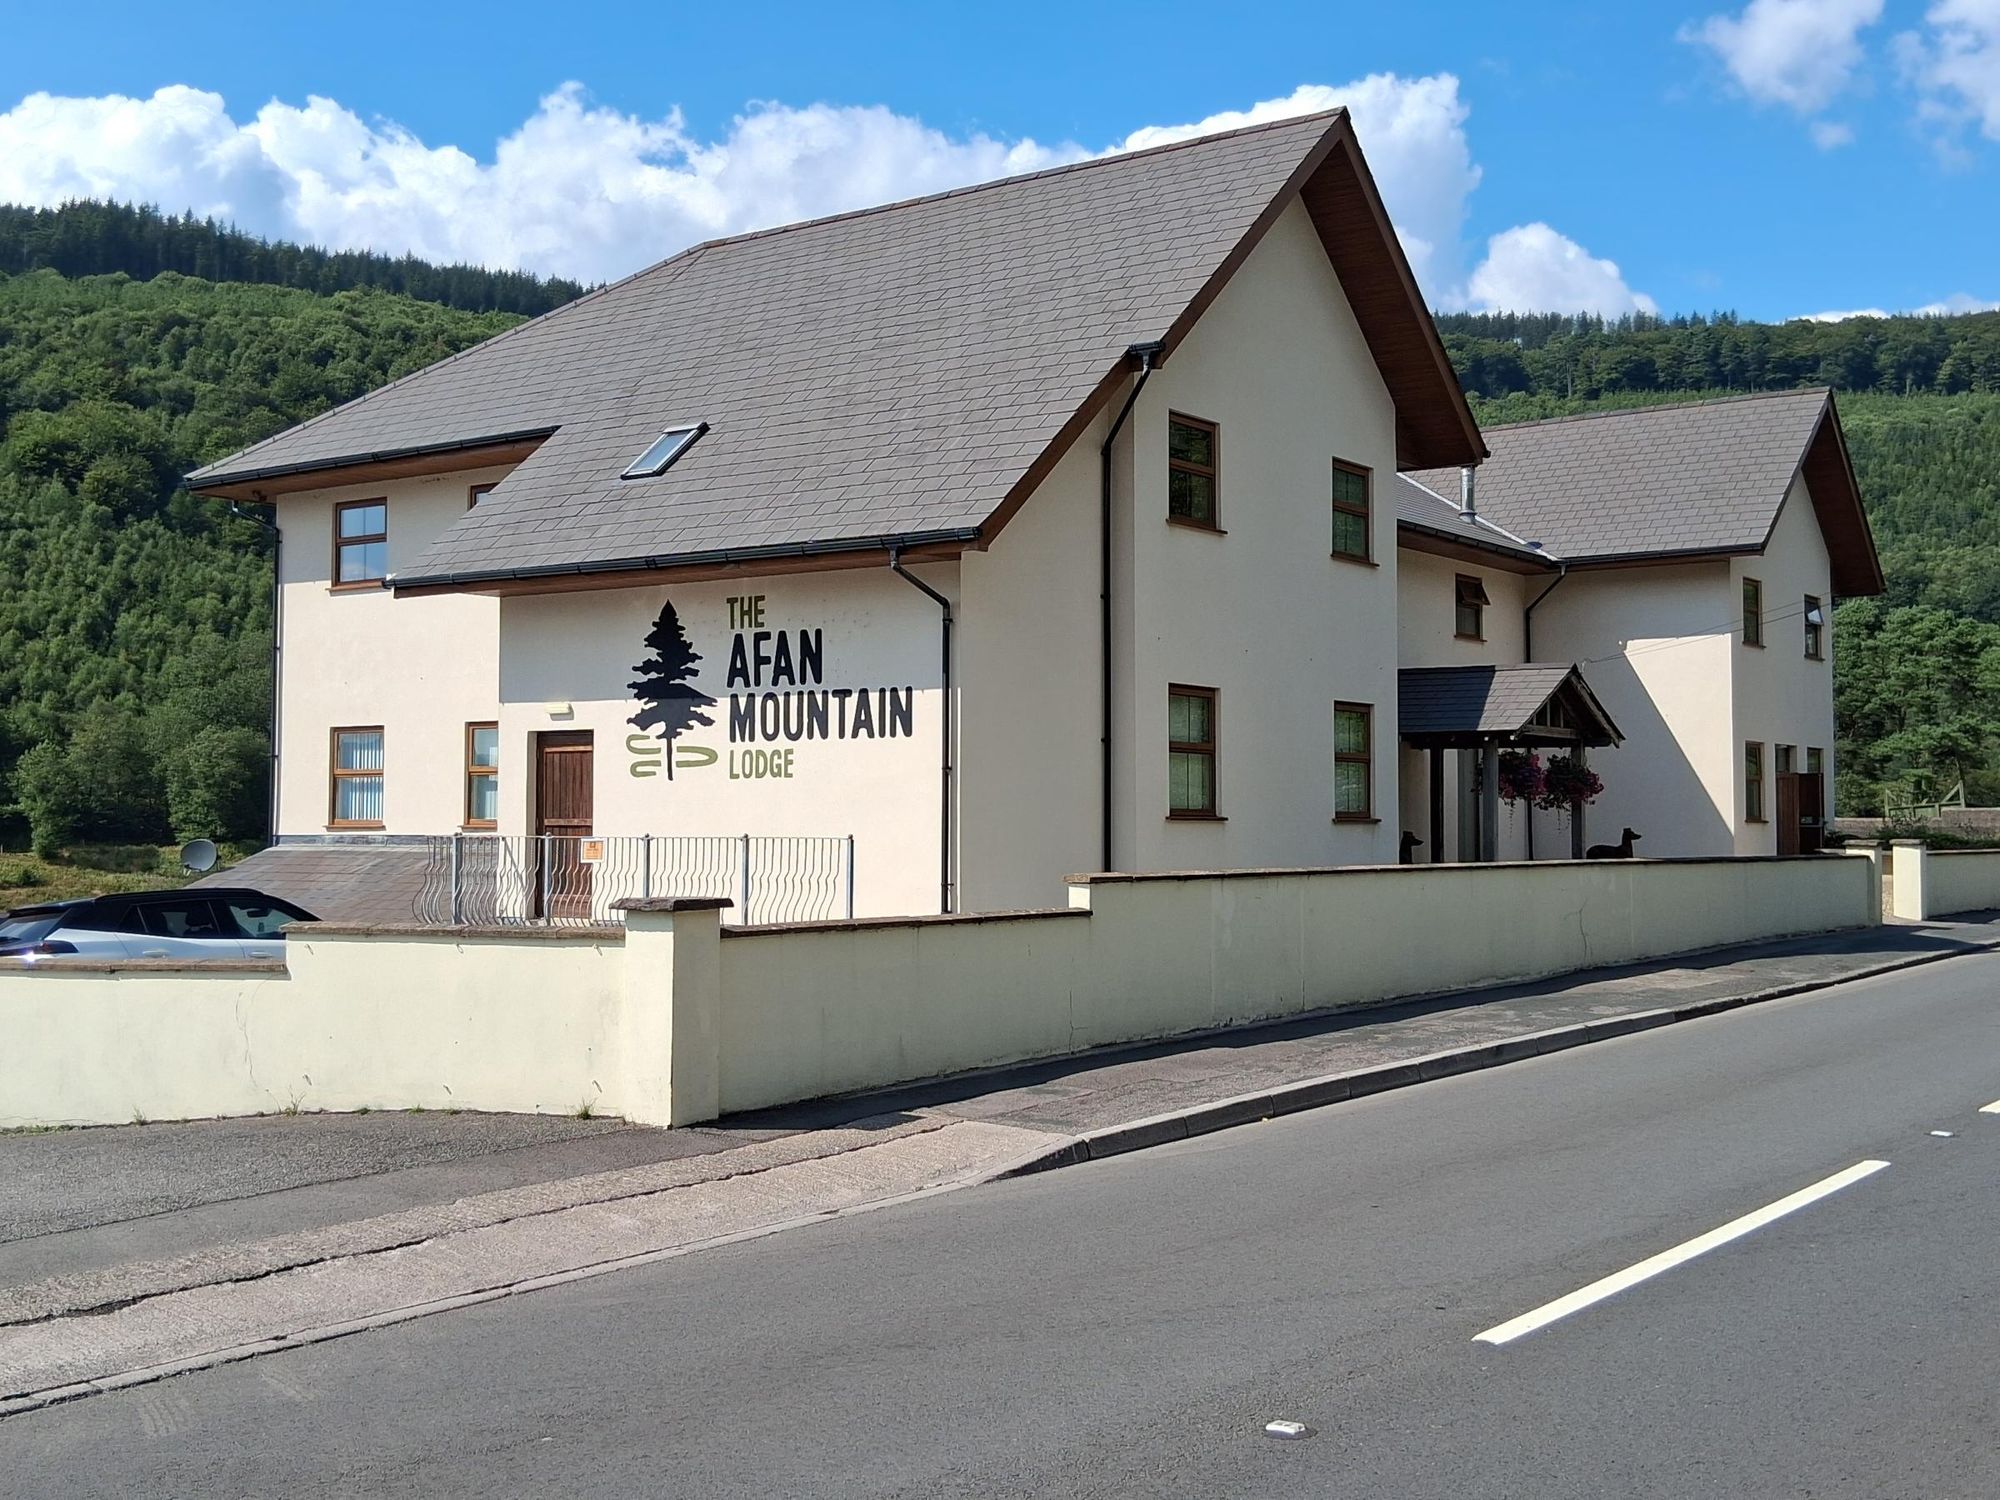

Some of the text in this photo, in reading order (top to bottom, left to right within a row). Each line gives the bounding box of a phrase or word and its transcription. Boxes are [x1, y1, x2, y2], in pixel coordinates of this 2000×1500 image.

[726, 595, 766, 629] THE
[726, 628, 823, 688] AFAN
[729, 686, 914, 743] MOUNTAIN
[729, 748, 795, 780] LODGE
